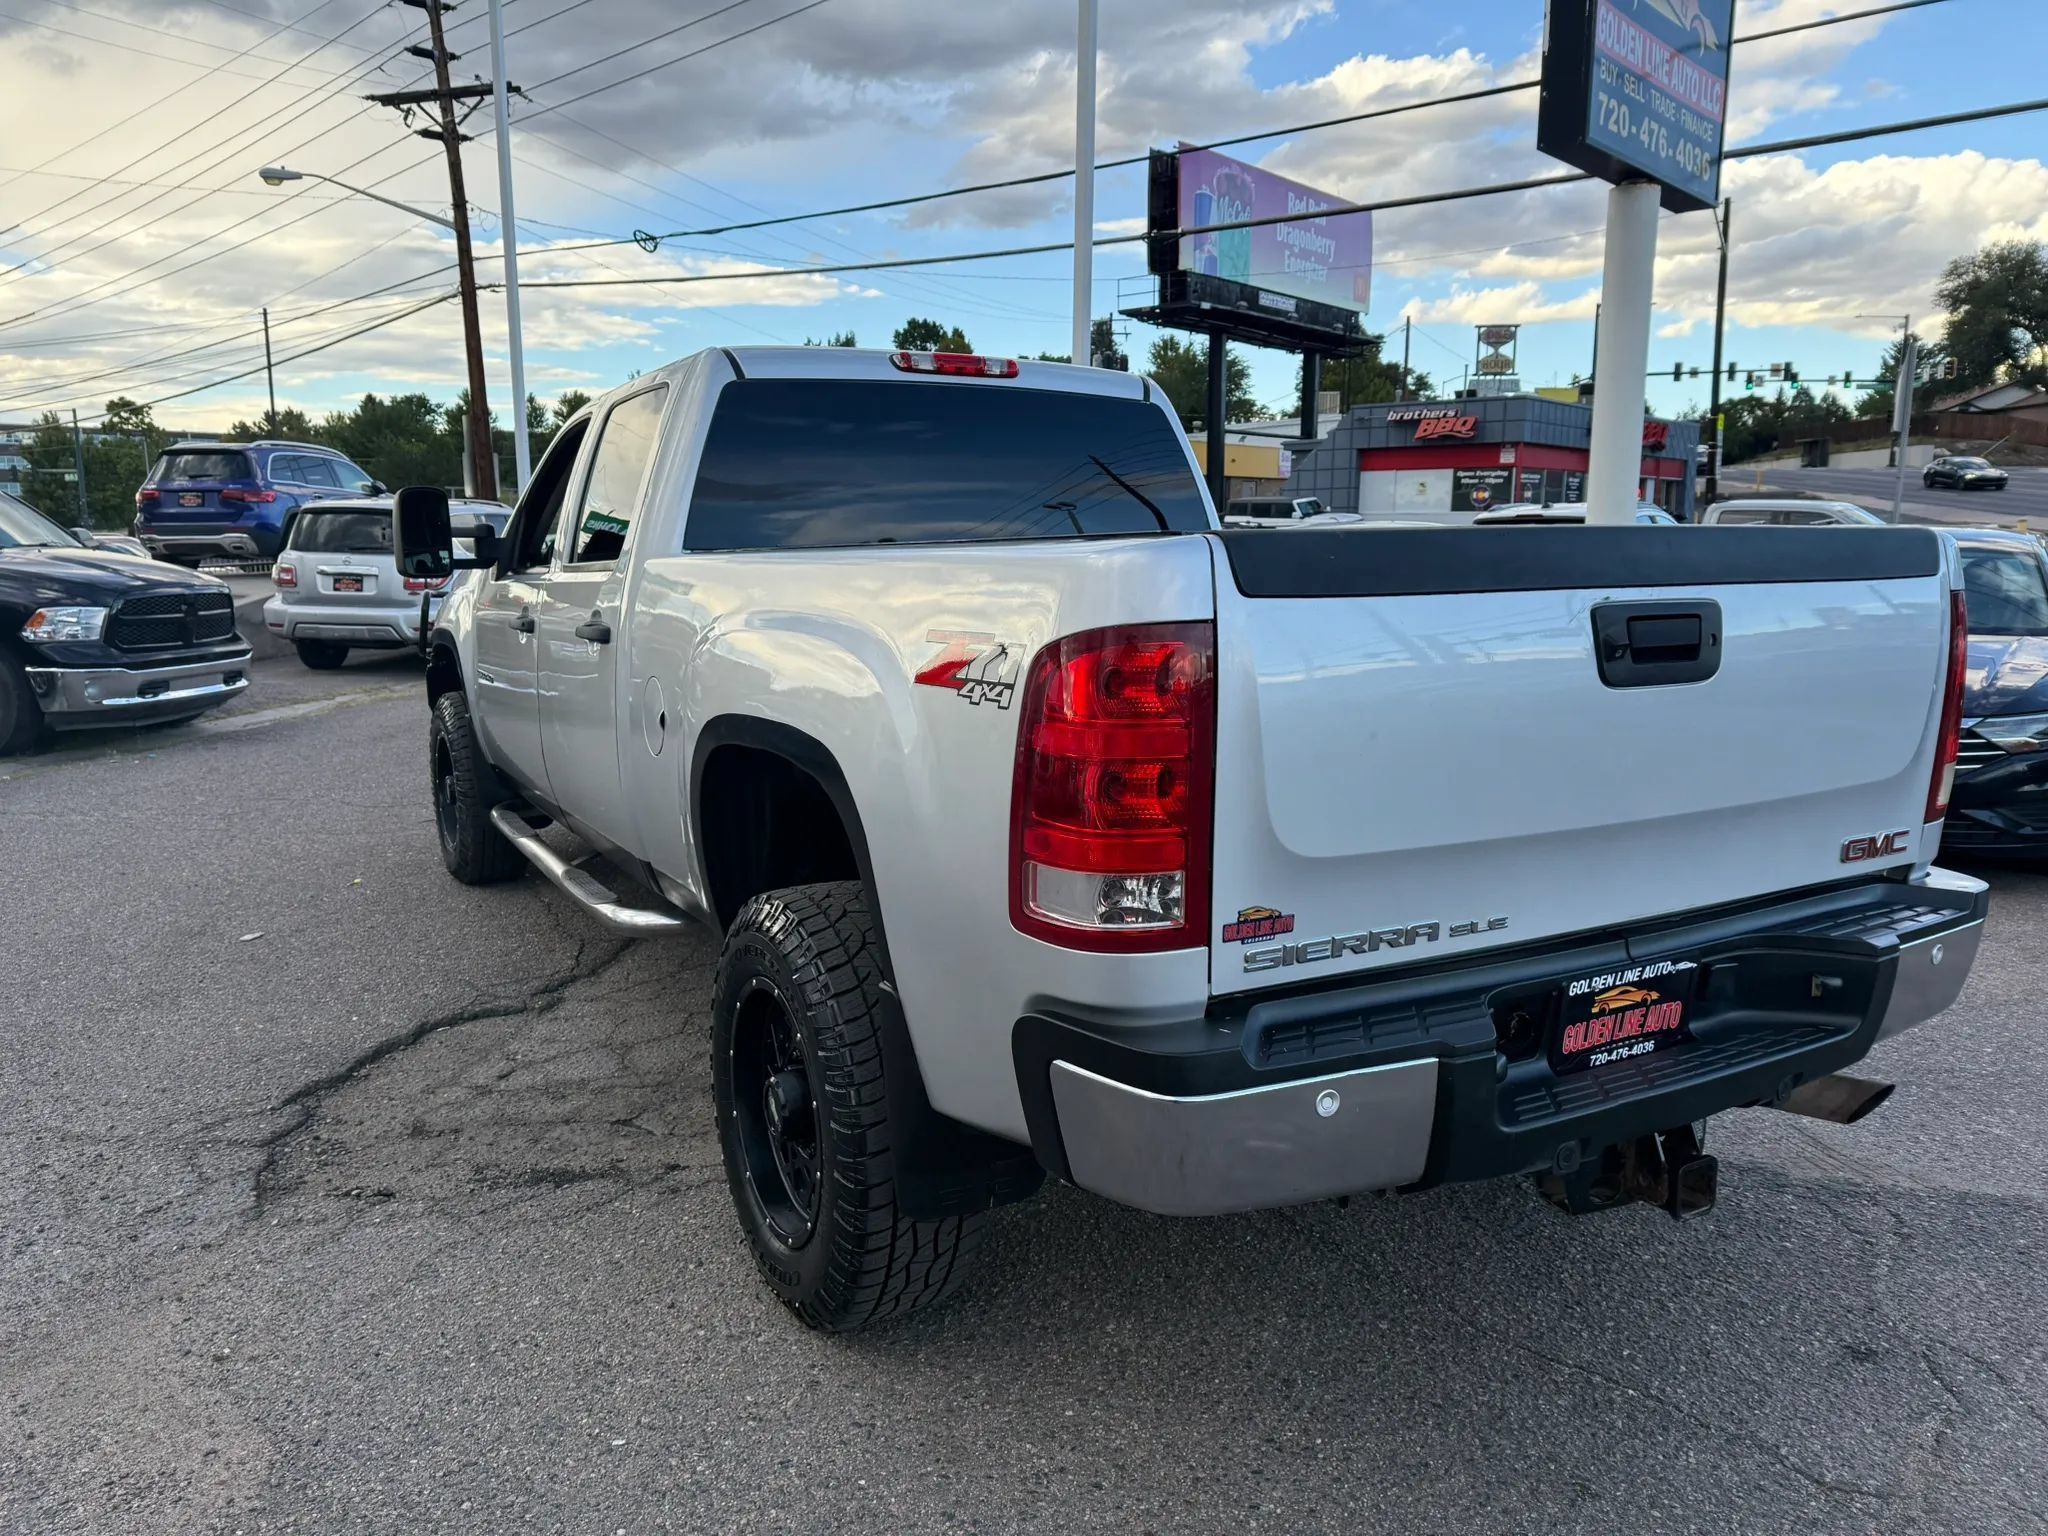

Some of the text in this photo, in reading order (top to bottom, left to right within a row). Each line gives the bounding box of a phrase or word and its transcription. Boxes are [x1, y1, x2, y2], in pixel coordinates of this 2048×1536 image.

[1599, 5, 1721, 114] GOLDEN LINE AUTO LLC
[1600, 58, 1714, 142] BUY SELL TRADE FINANCE
[1598, 91, 1712, 181] 720-476-4036
[1288, 191, 1307, 216] Red
[1276, 221, 1336, 262] Dragonberry
[1284, 250, 1328, 284] Energizer
[1387, 408, 1459, 420] brothers
[1414, 415, 1477, 439] BBQ
[1840, 827, 1911, 863] GMC
[1224, 916, 1293, 940] GOLDEN LINE AUTO
[1243, 916, 1509, 973] SIERRA SLE
[1568, 961, 1672, 997] GOLDEN LINE AUTO
[1562, 1014, 1616, 1055] GOLDEN
[1613, 1007, 1647, 1040] LINE
[1643, 1000, 1683, 1034] AUTO
[1589, 1040, 1655, 1067] 720-476-4036
